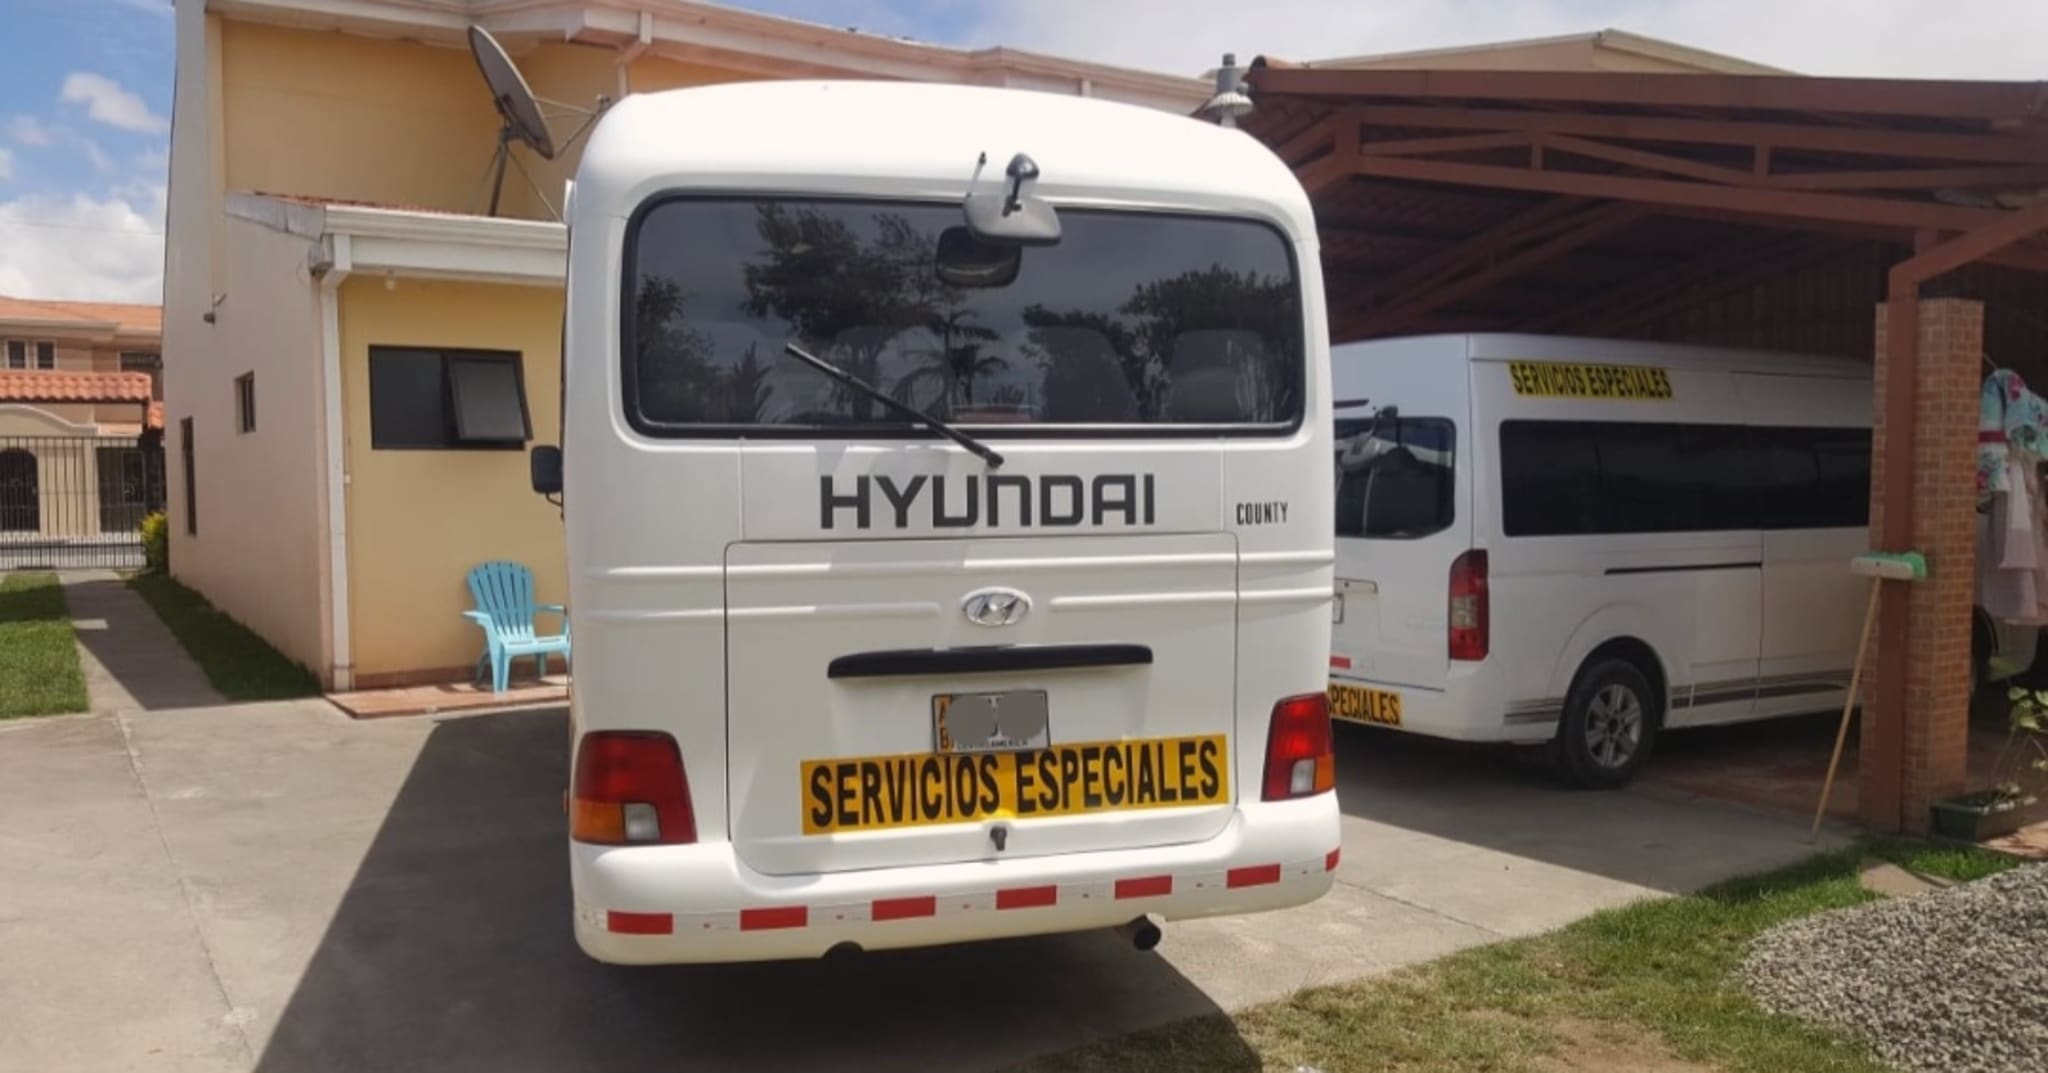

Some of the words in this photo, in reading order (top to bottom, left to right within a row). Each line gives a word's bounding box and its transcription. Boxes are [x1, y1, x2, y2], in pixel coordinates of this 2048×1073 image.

[1509, 363, 1586, 395] SERVICIOS
[1585, 367, 1672, 398] ESPECIALES
[820, 474, 1155, 529] HYUNDAI
[1236, 502, 1289, 525] COUNTY
[810, 752, 1000, 828] SERVICIOS
[1016, 740, 1219, 814] ESPECIALES
